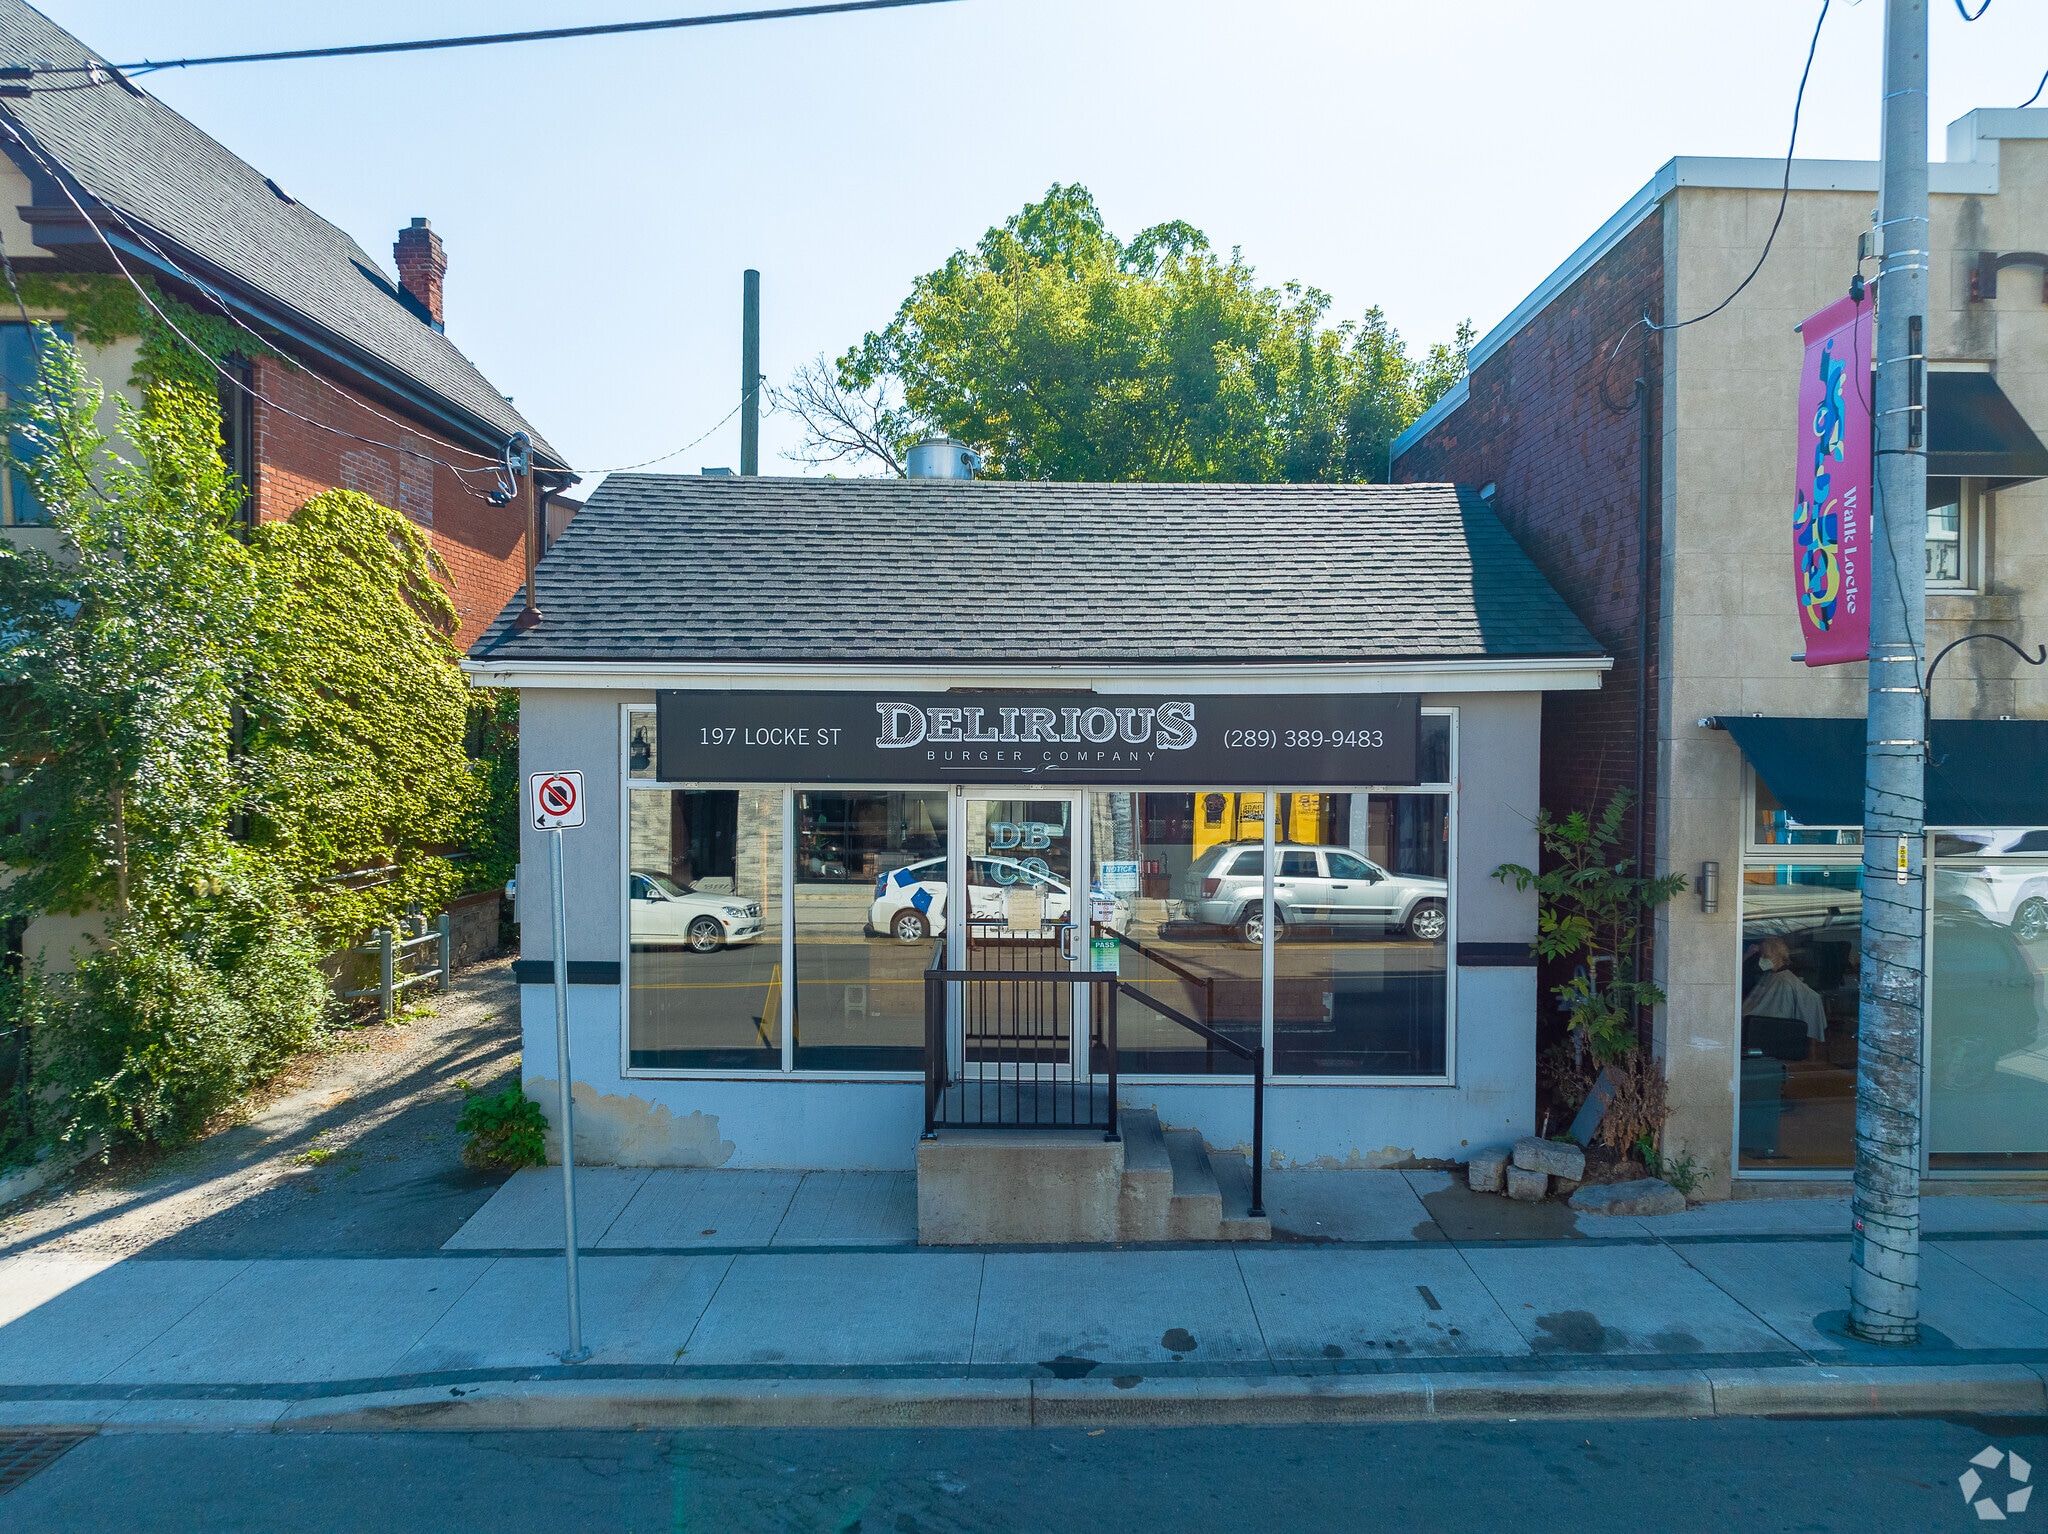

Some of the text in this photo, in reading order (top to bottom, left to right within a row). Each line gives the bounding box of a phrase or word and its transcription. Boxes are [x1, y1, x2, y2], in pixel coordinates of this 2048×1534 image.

[1843, 485, 1859, 615] Walk Locke
[876, 701, 1197, 750] DELIRIOUS
[700, 727, 842, 746] 197 LOCKE ST
[1223, 729, 1384, 749] (289) 389-9483
[927, 750, 1156, 762] BURGER COMPANY
[990, 821, 1051, 849] DB
[1105, 864, 1135, 873] NOTICE
